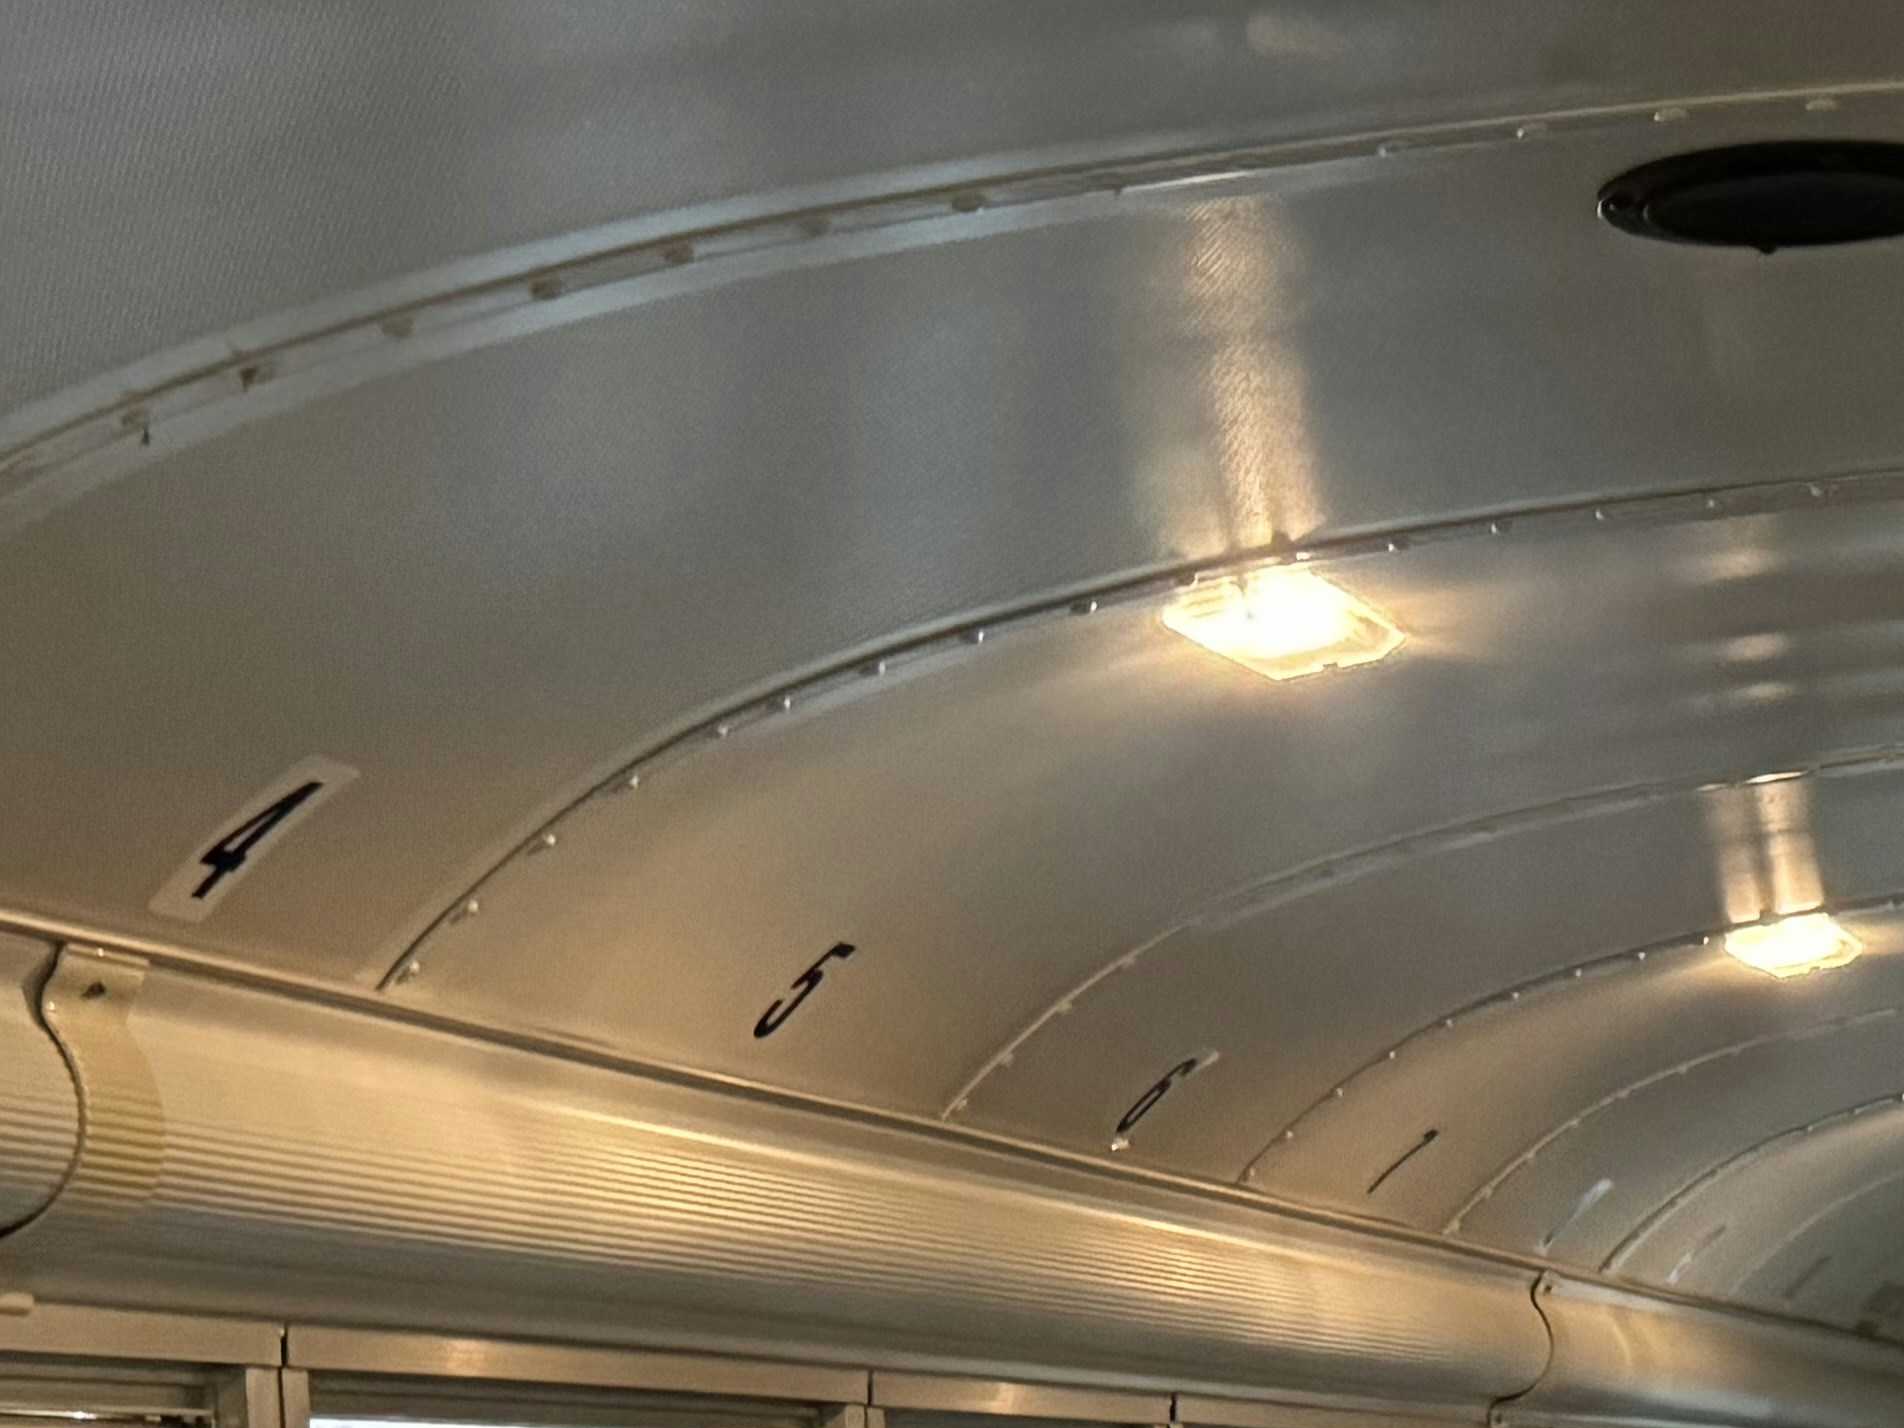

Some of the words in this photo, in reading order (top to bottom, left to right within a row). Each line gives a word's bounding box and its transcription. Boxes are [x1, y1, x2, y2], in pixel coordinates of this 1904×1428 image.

[190, 781, 324, 900] 4
[752, 941, 857, 1040] 5
[1116, 1057, 1198, 1135] 6
